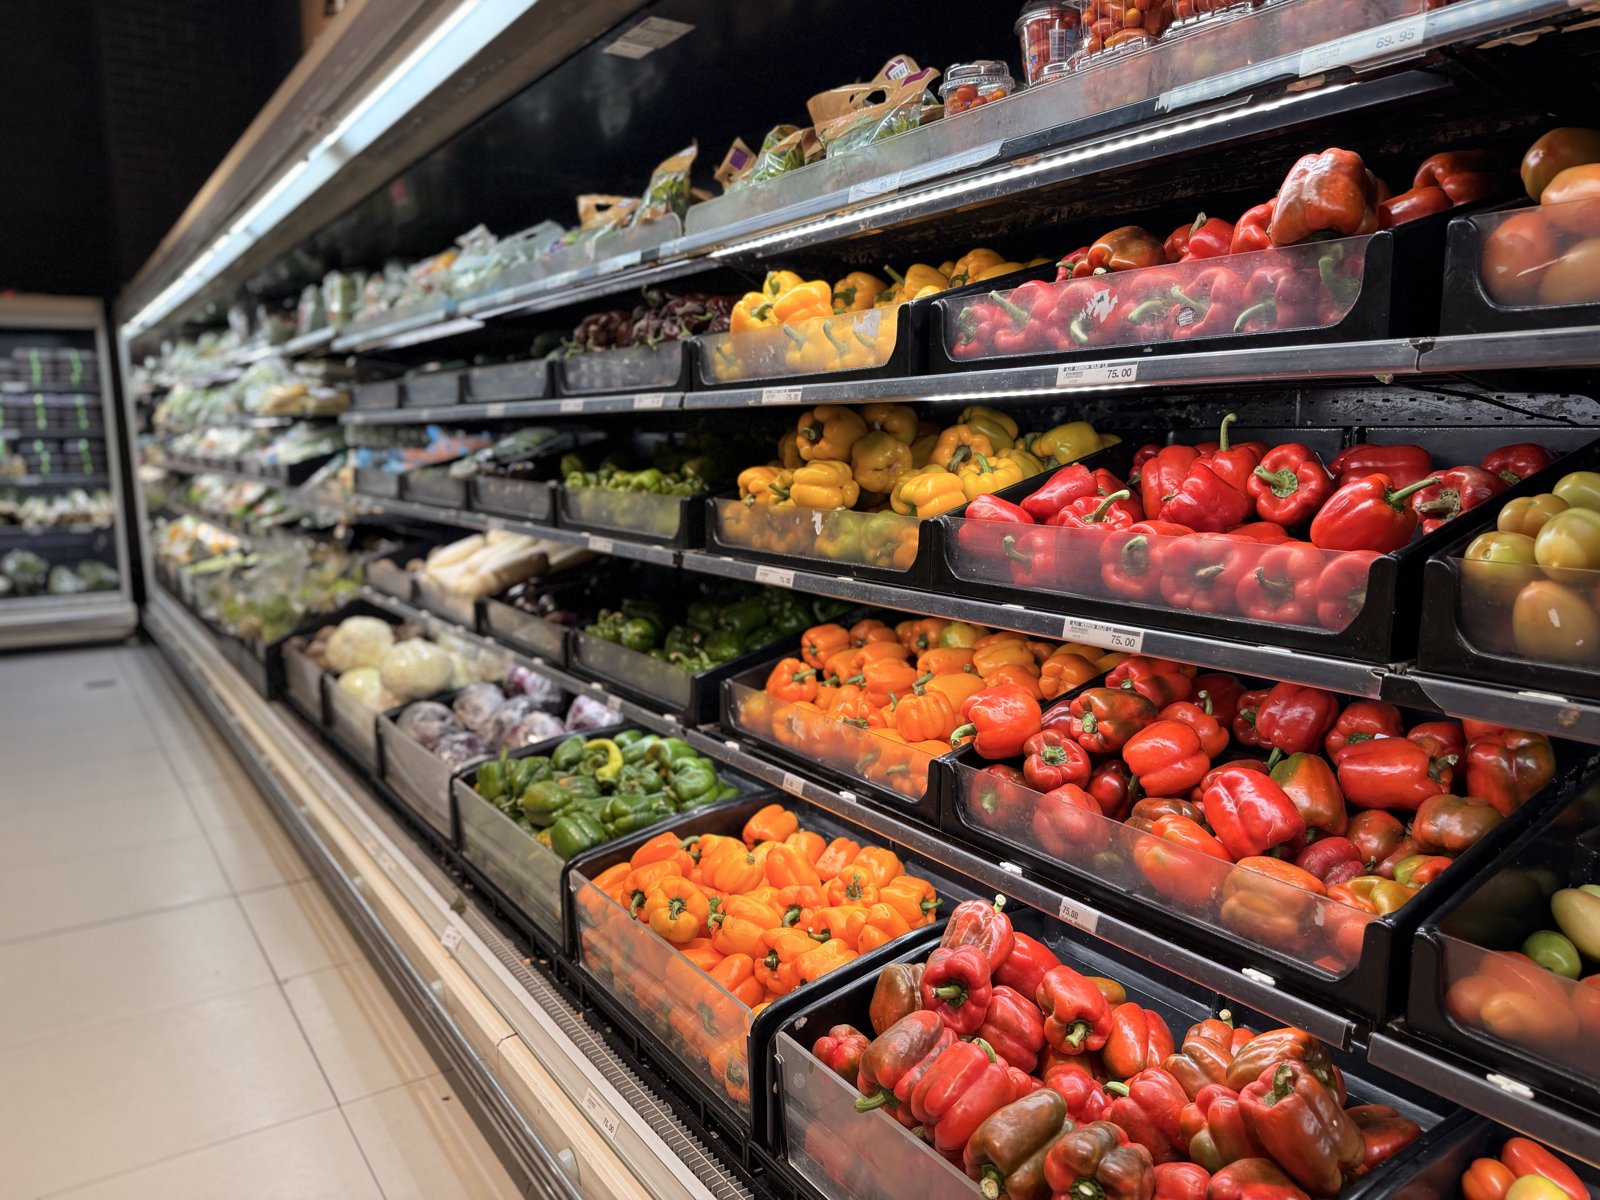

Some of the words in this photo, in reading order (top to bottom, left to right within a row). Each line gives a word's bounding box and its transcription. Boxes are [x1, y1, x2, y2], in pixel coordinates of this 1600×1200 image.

[1376, 28, 1415, 49] 69.95
[1107, 368, 1132, 379] 75.00
[1111, 635, 1136, 647] 75.00
